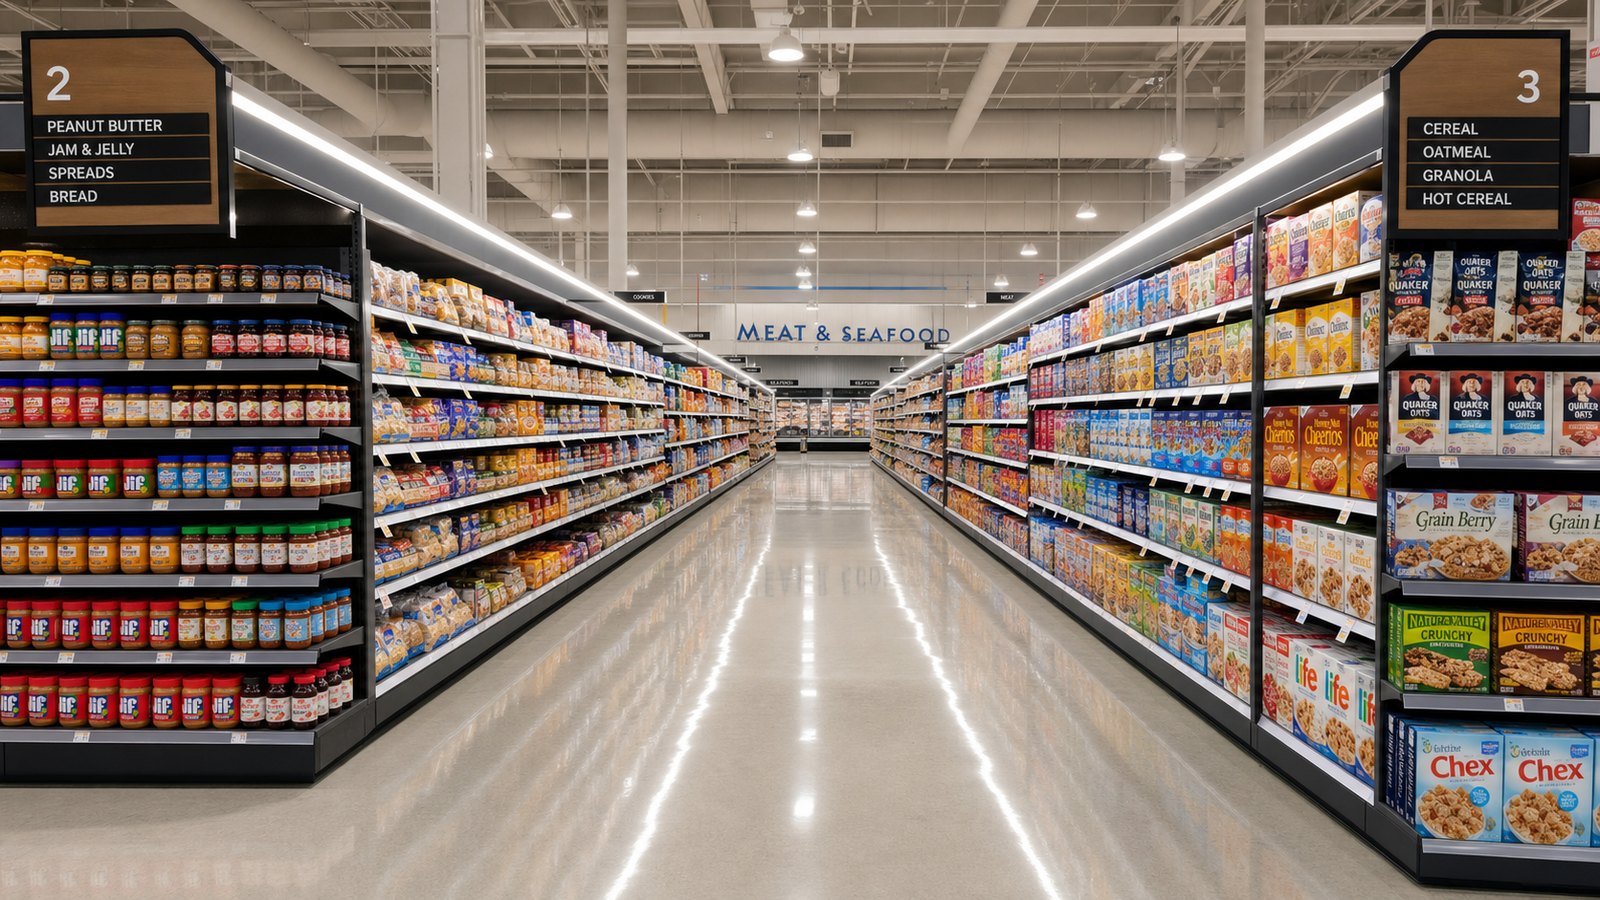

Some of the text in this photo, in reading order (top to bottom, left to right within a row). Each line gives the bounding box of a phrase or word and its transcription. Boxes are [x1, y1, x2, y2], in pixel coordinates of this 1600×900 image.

[47, 66, 71, 101] 2
[1516, 69, 1541, 103] 3
[47, 119, 162, 133] PEANUT BUTTER
[1423, 122, 1479, 135] CEREAL
[48, 142, 135, 157] JAM & JELLY
[1423, 146, 1491, 159] OATMEAL
[48, 166, 115, 180] SPREADS
[1422, 169, 1494, 182] GRANOLA
[50, 190, 98, 203] BREAD
[1422, 192, 1512, 206] HOT CEREAL
[1389, 280, 1428, 292] QUAKER
[1457, 280, 1493, 292] QUAKER
[1523, 280, 1561, 292] QUAKER
[737, 323, 950, 343] MEAT & SEAFOOD
[1403, 400, 1438, 410] QUAKER
[1453, 400, 1489, 410] QUAKER
[1507, 401, 1542, 411] QUAKER
[1568, 402, 1599, 412] QUAKER
[1305, 426, 1342, 446] Cheerios
[1416, 511, 1497, 532] Grain Berry
[1549, 513, 1589, 535] Grain
[1421, 630, 1473, 641] CRUNCHY
[1515, 632, 1568, 644] CRUNCHY
[1296, 654, 1318, 692] life
[1325, 670, 1350, 711] life
[1430, 755, 1495, 778] Chex
[1518, 759, 1585, 783] Chex
